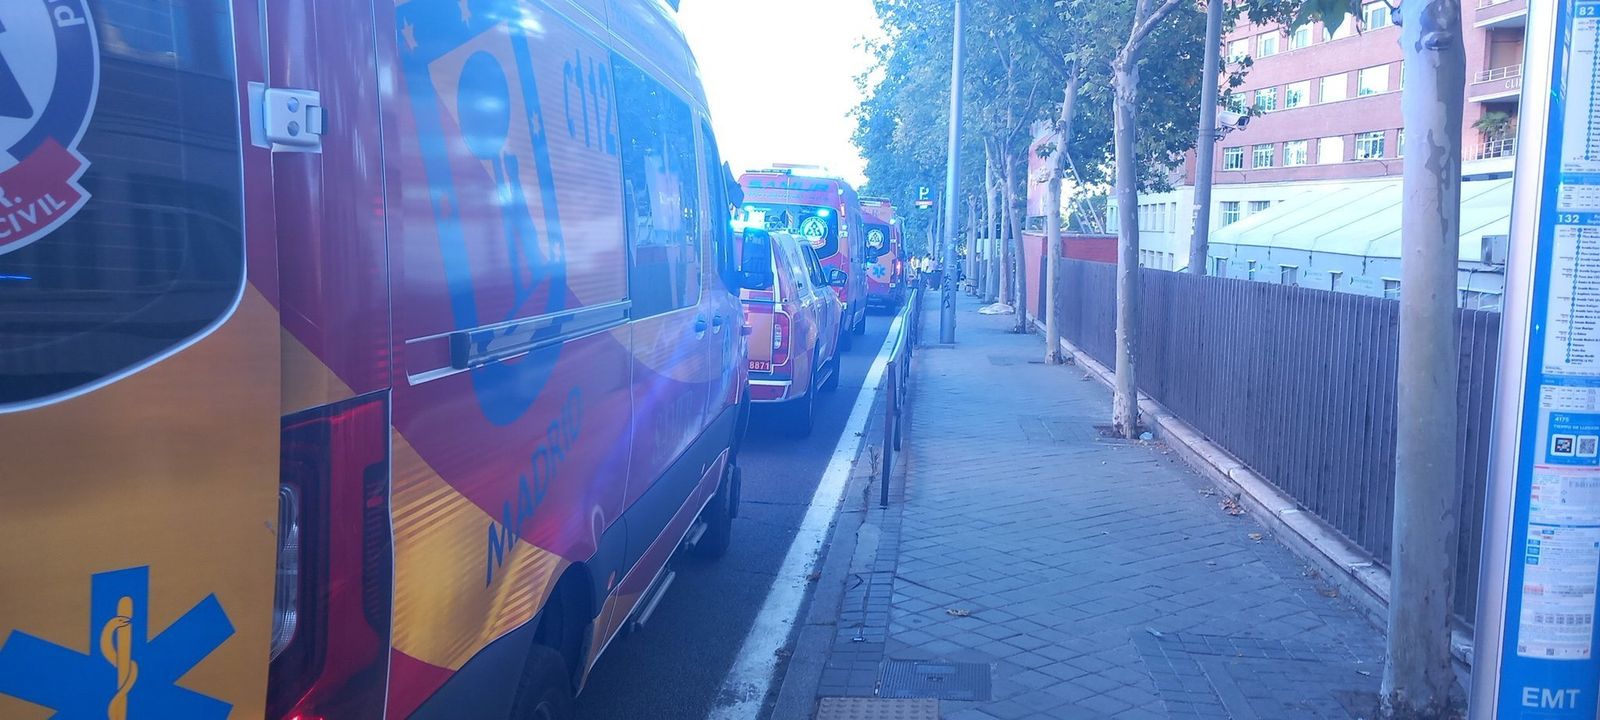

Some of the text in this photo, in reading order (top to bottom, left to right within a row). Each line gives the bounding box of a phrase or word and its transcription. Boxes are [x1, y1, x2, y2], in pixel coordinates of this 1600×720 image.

[1579, 6, 1595, 16] 82
[0, 193, 67, 239] CIVIL
[1558, 214, 1580, 223] 132
[749, 361, 770, 370] 8871
[486, 386, 583, 588] MADRID
[1521, 686, 1581, 709] EMT
